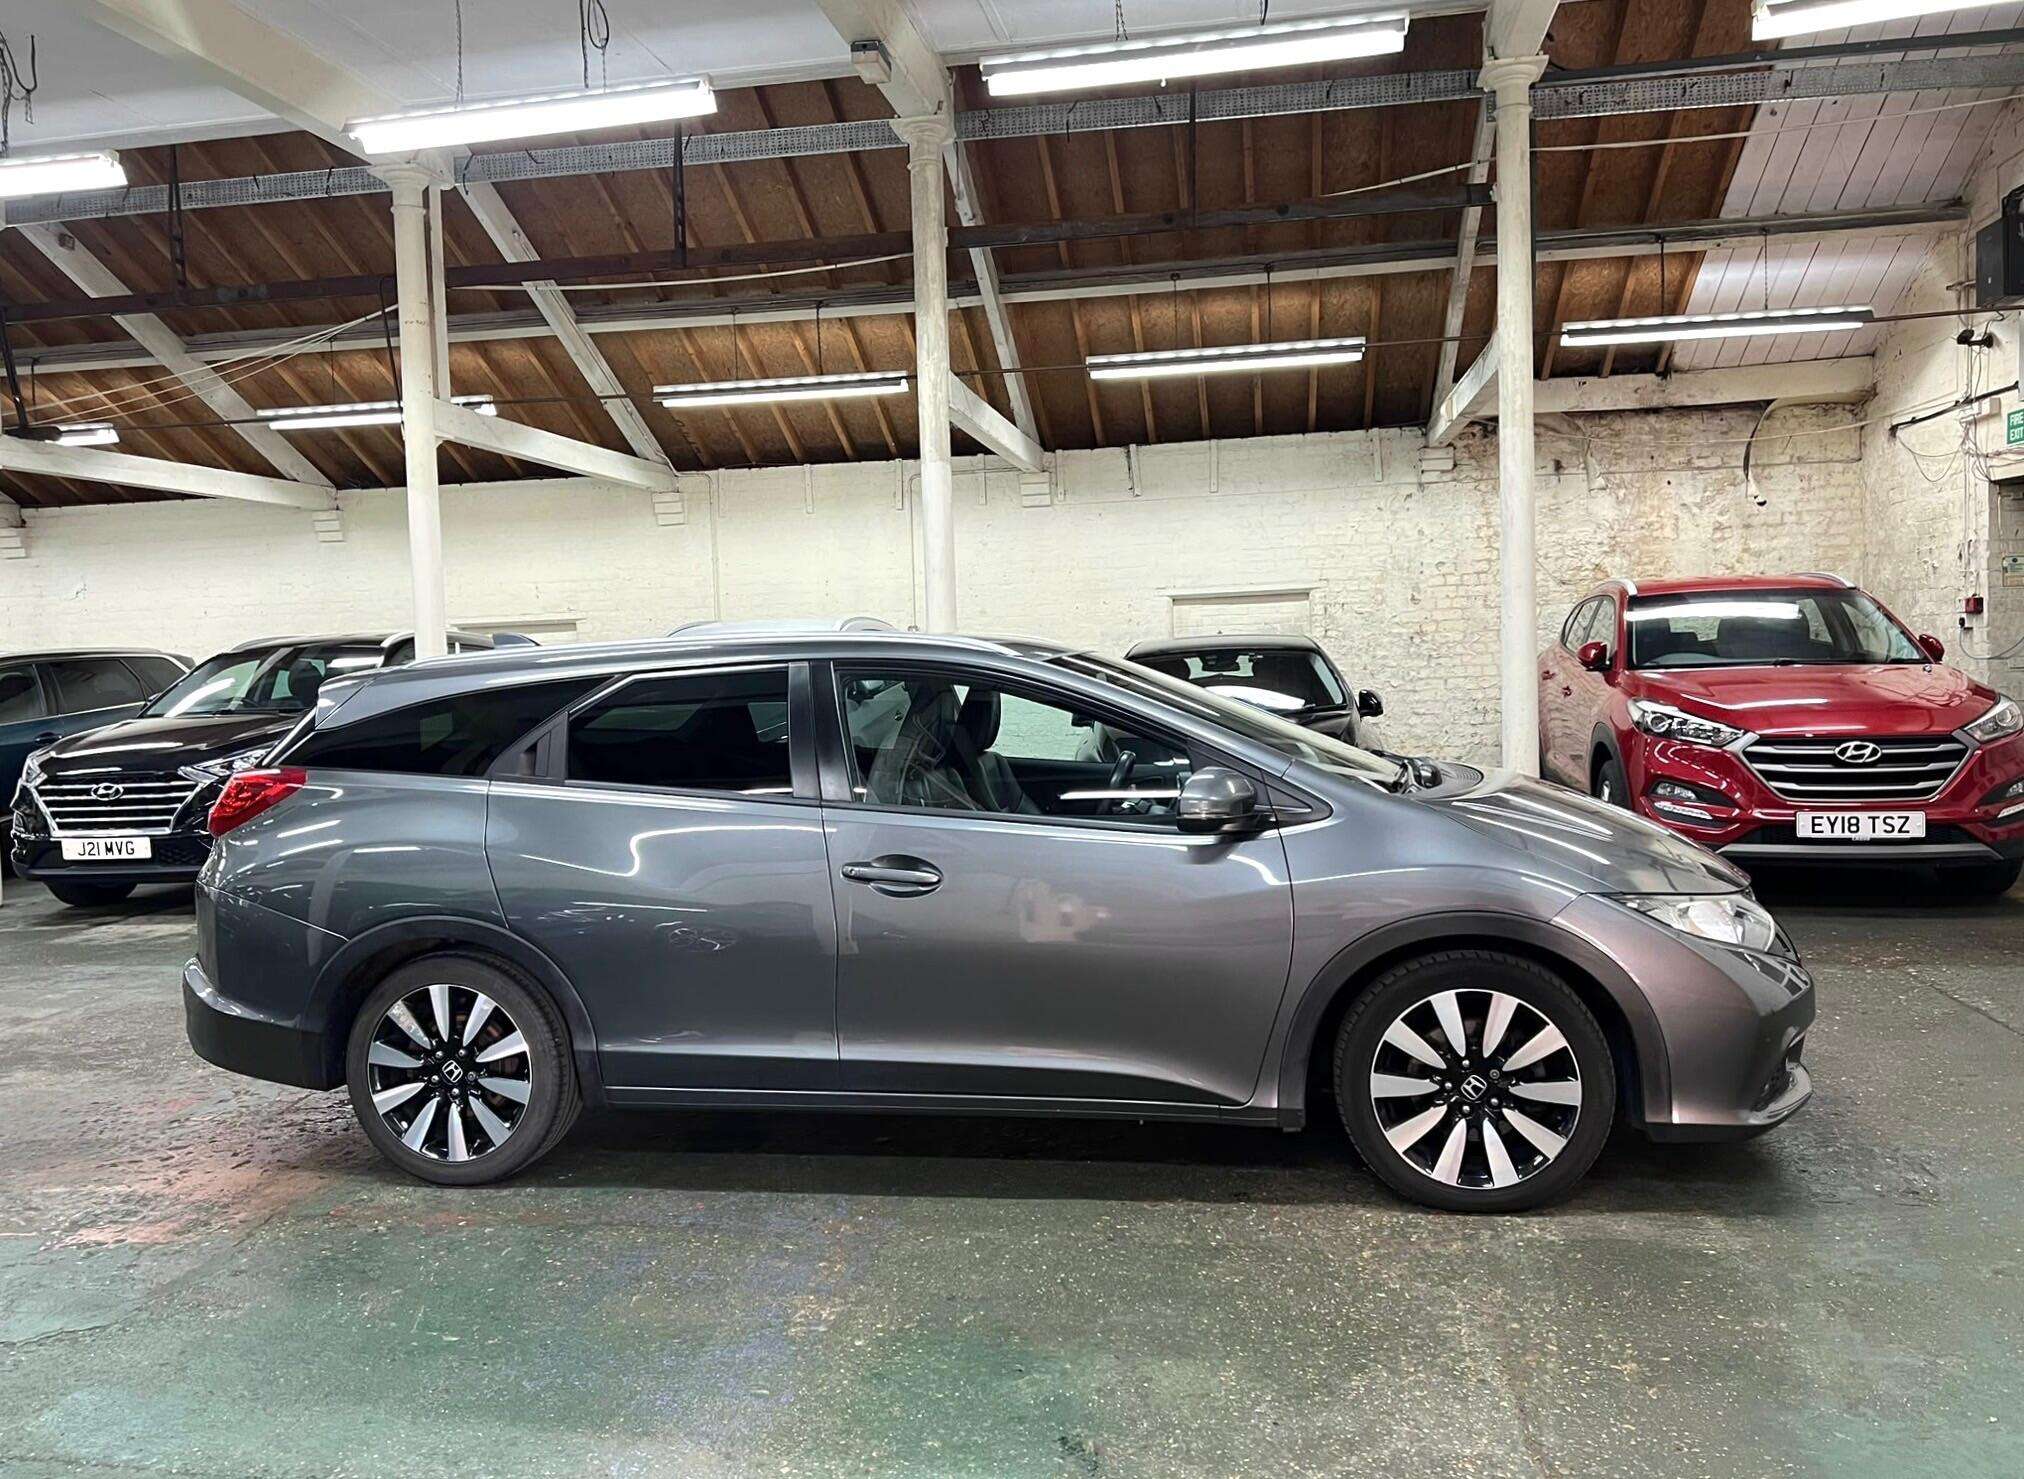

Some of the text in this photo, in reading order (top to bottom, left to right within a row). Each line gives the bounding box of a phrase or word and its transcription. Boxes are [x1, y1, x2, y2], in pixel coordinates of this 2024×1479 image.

[1811, 816, 1910, 834] EY18 TSZ
[78, 841, 135, 856] J21 MVG
